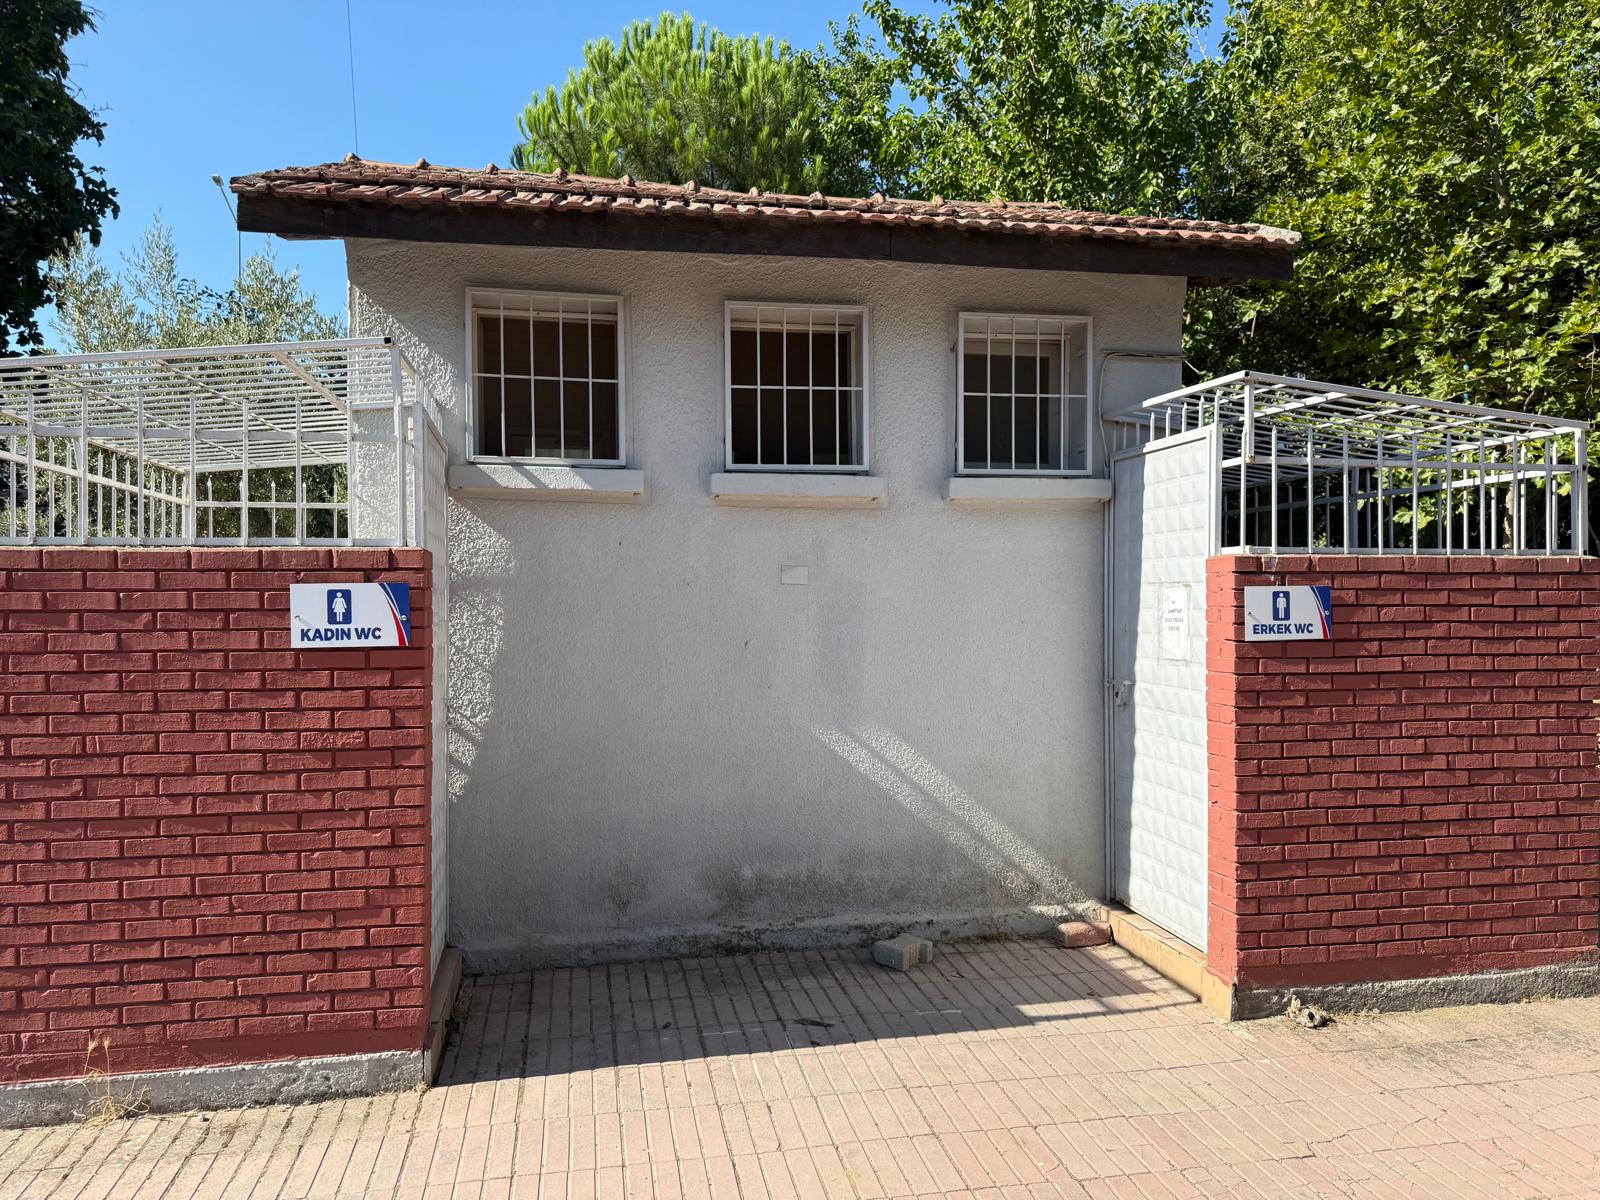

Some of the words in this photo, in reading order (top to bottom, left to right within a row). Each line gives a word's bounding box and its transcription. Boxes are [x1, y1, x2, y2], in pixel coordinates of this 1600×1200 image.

[300, 627, 352, 641] KADIN
[354, 627, 382, 640] WC
[1252, 623, 1292, 635] ERKEK
[1294, 622, 1314, 634] WC
